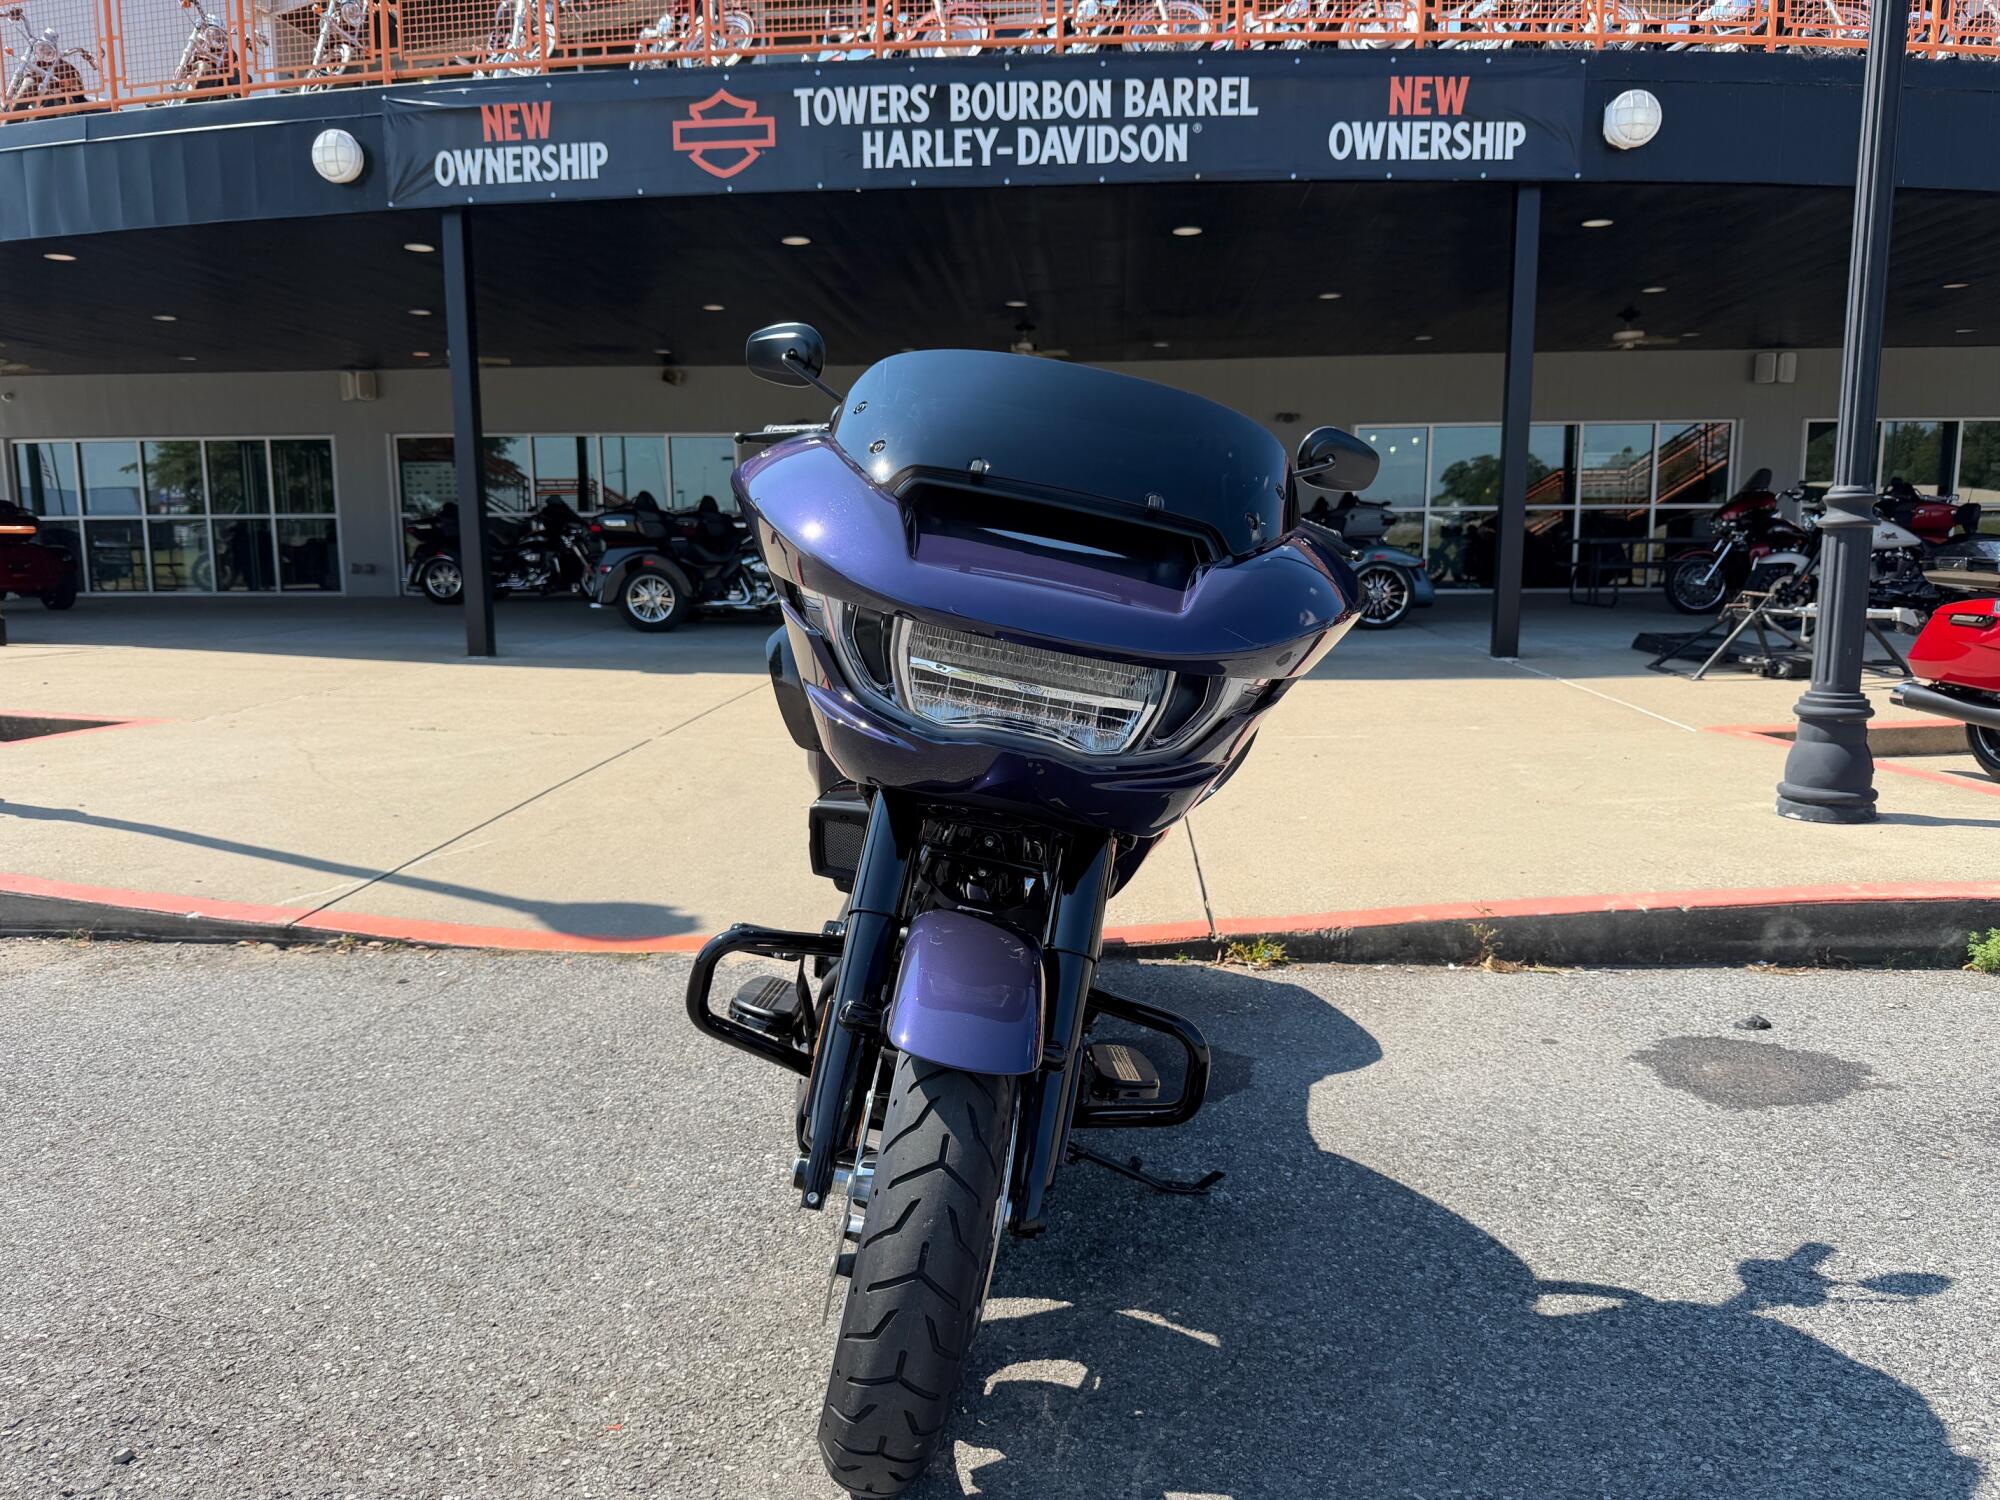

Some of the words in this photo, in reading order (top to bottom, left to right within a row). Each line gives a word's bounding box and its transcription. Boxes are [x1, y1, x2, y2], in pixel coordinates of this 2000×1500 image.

[949, 79, 1112, 122] BOURBON
[1124, 76, 1259, 118] BARREL
[1388, 76, 1470, 116] NEW
[480, 100, 552, 142] NEW
[1328, 121, 1527, 161] OWNERSHIP
[434, 142, 609, 187] OWNERSHIP
